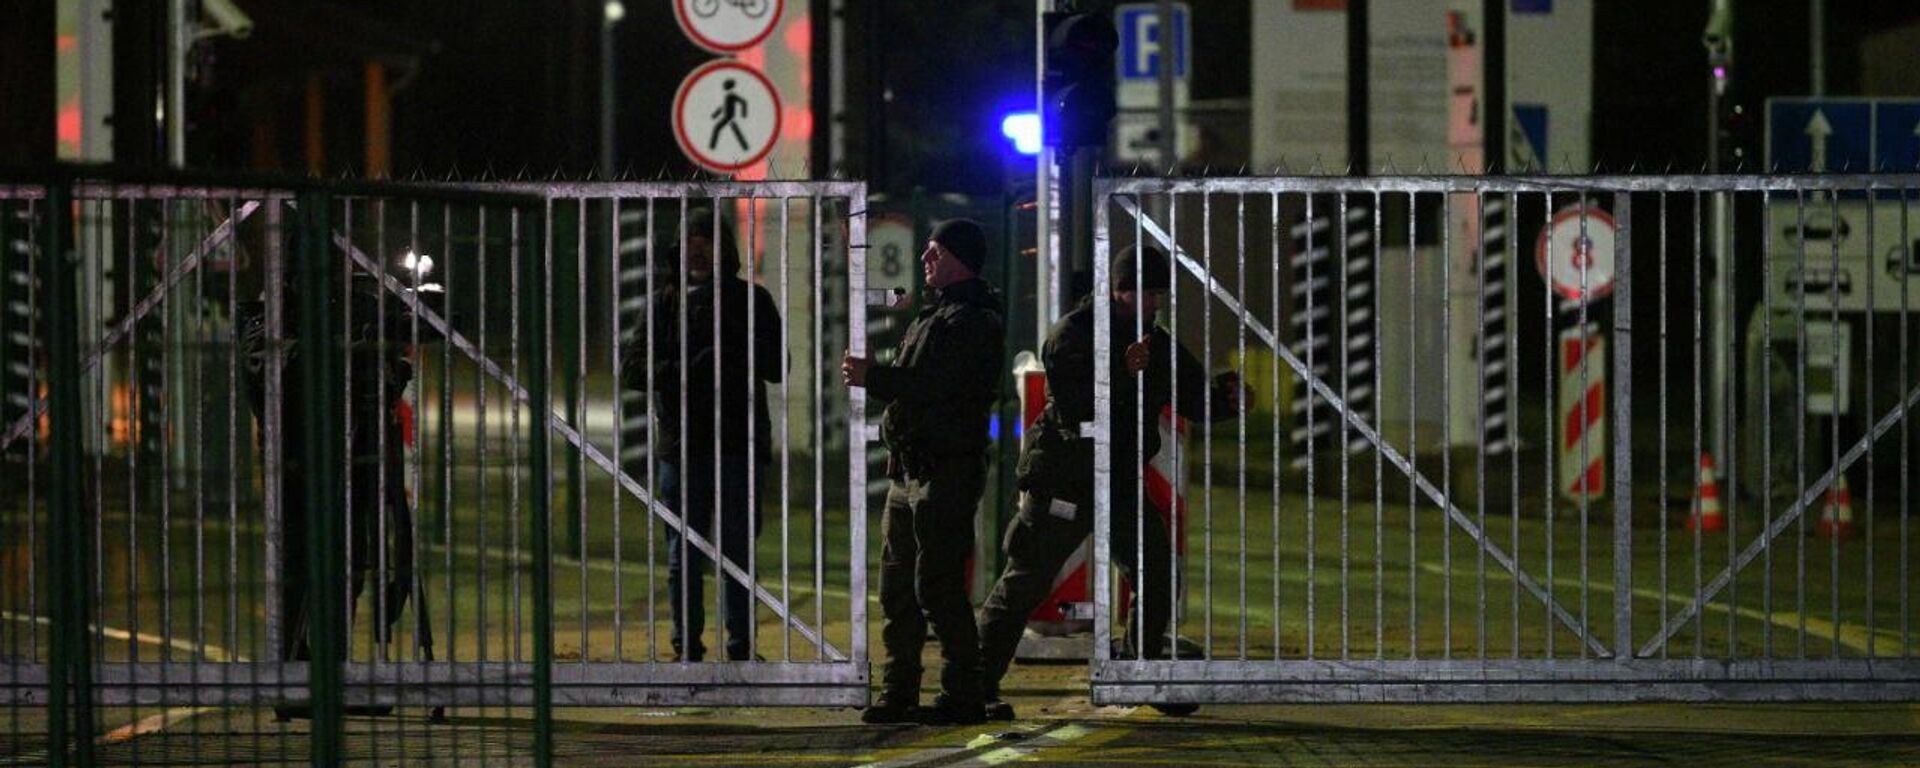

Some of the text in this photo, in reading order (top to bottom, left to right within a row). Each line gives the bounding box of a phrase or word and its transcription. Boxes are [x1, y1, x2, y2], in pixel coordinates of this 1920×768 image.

[1135, 13, 1169, 73] P
[881, 243, 900, 277] 8
[1572, 237, 1593, 270] 8
